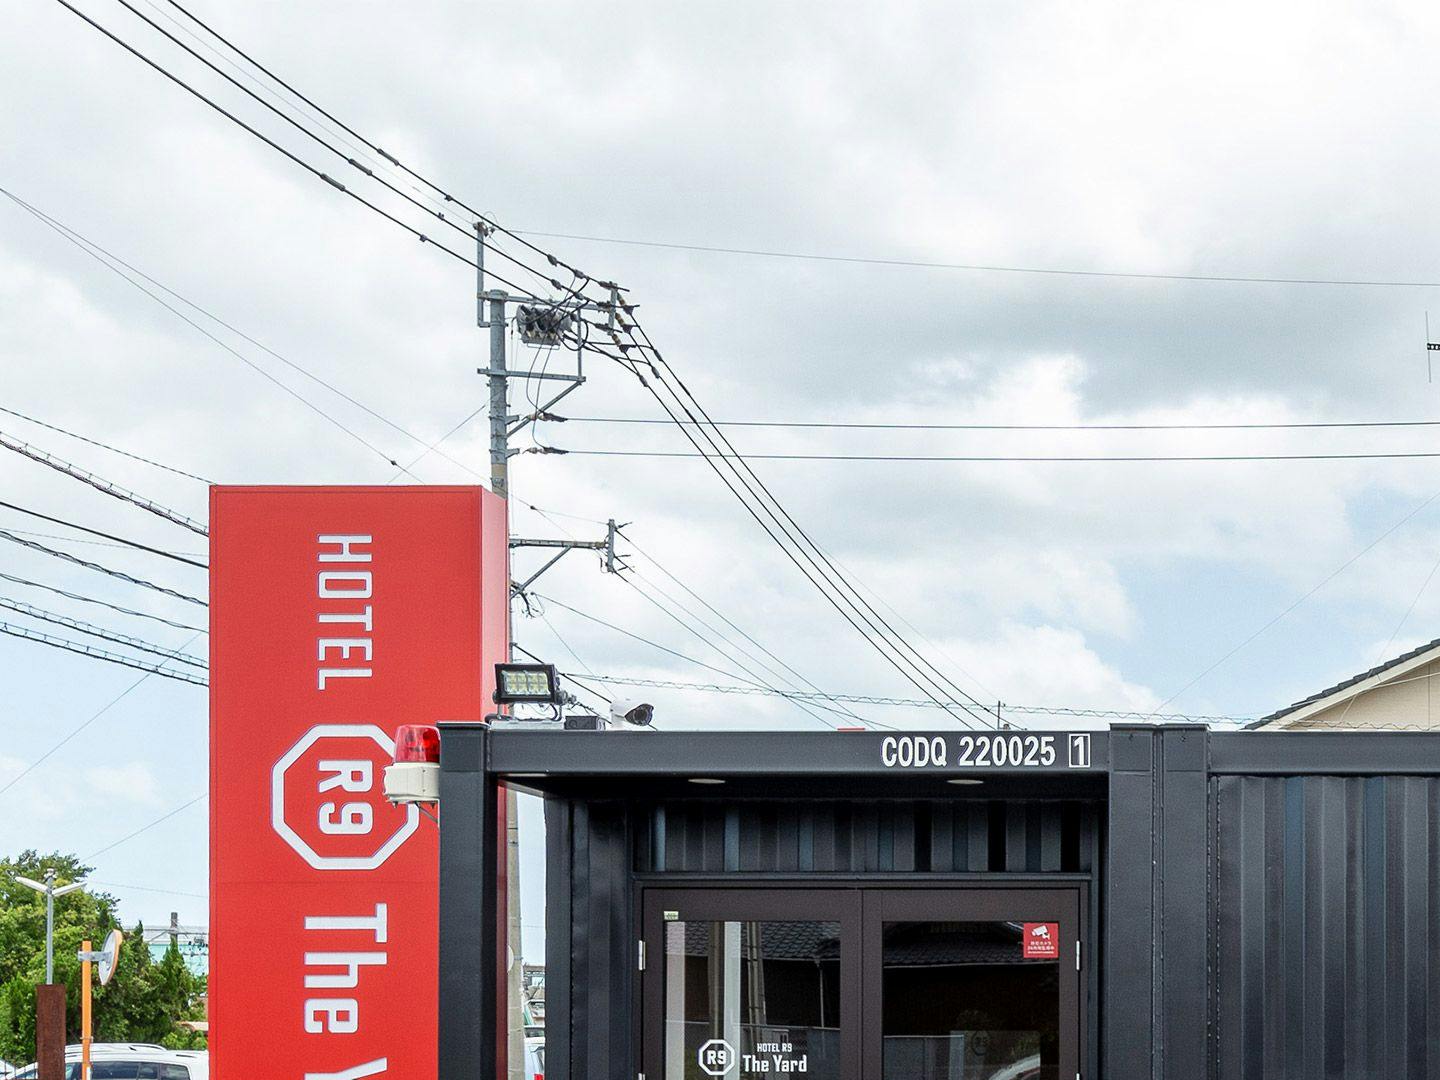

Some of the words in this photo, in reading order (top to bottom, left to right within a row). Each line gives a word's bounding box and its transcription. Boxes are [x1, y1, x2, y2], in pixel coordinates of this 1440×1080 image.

[317, 533, 372, 690] HOTEL
[881, 736, 947, 767] CODQ
[958, 736, 1056, 766] 220025
[318, 759, 373, 834] R9
[304, 903, 387, 1033] The
[706, 1049, 727, 1065] R9
[756, 1042, 780, 1053] HOTEL
[781, 1042, 793, 1053] R9
[742, 1054, 770, 1073] The
[772, 1054, 808, 1073] Yard
